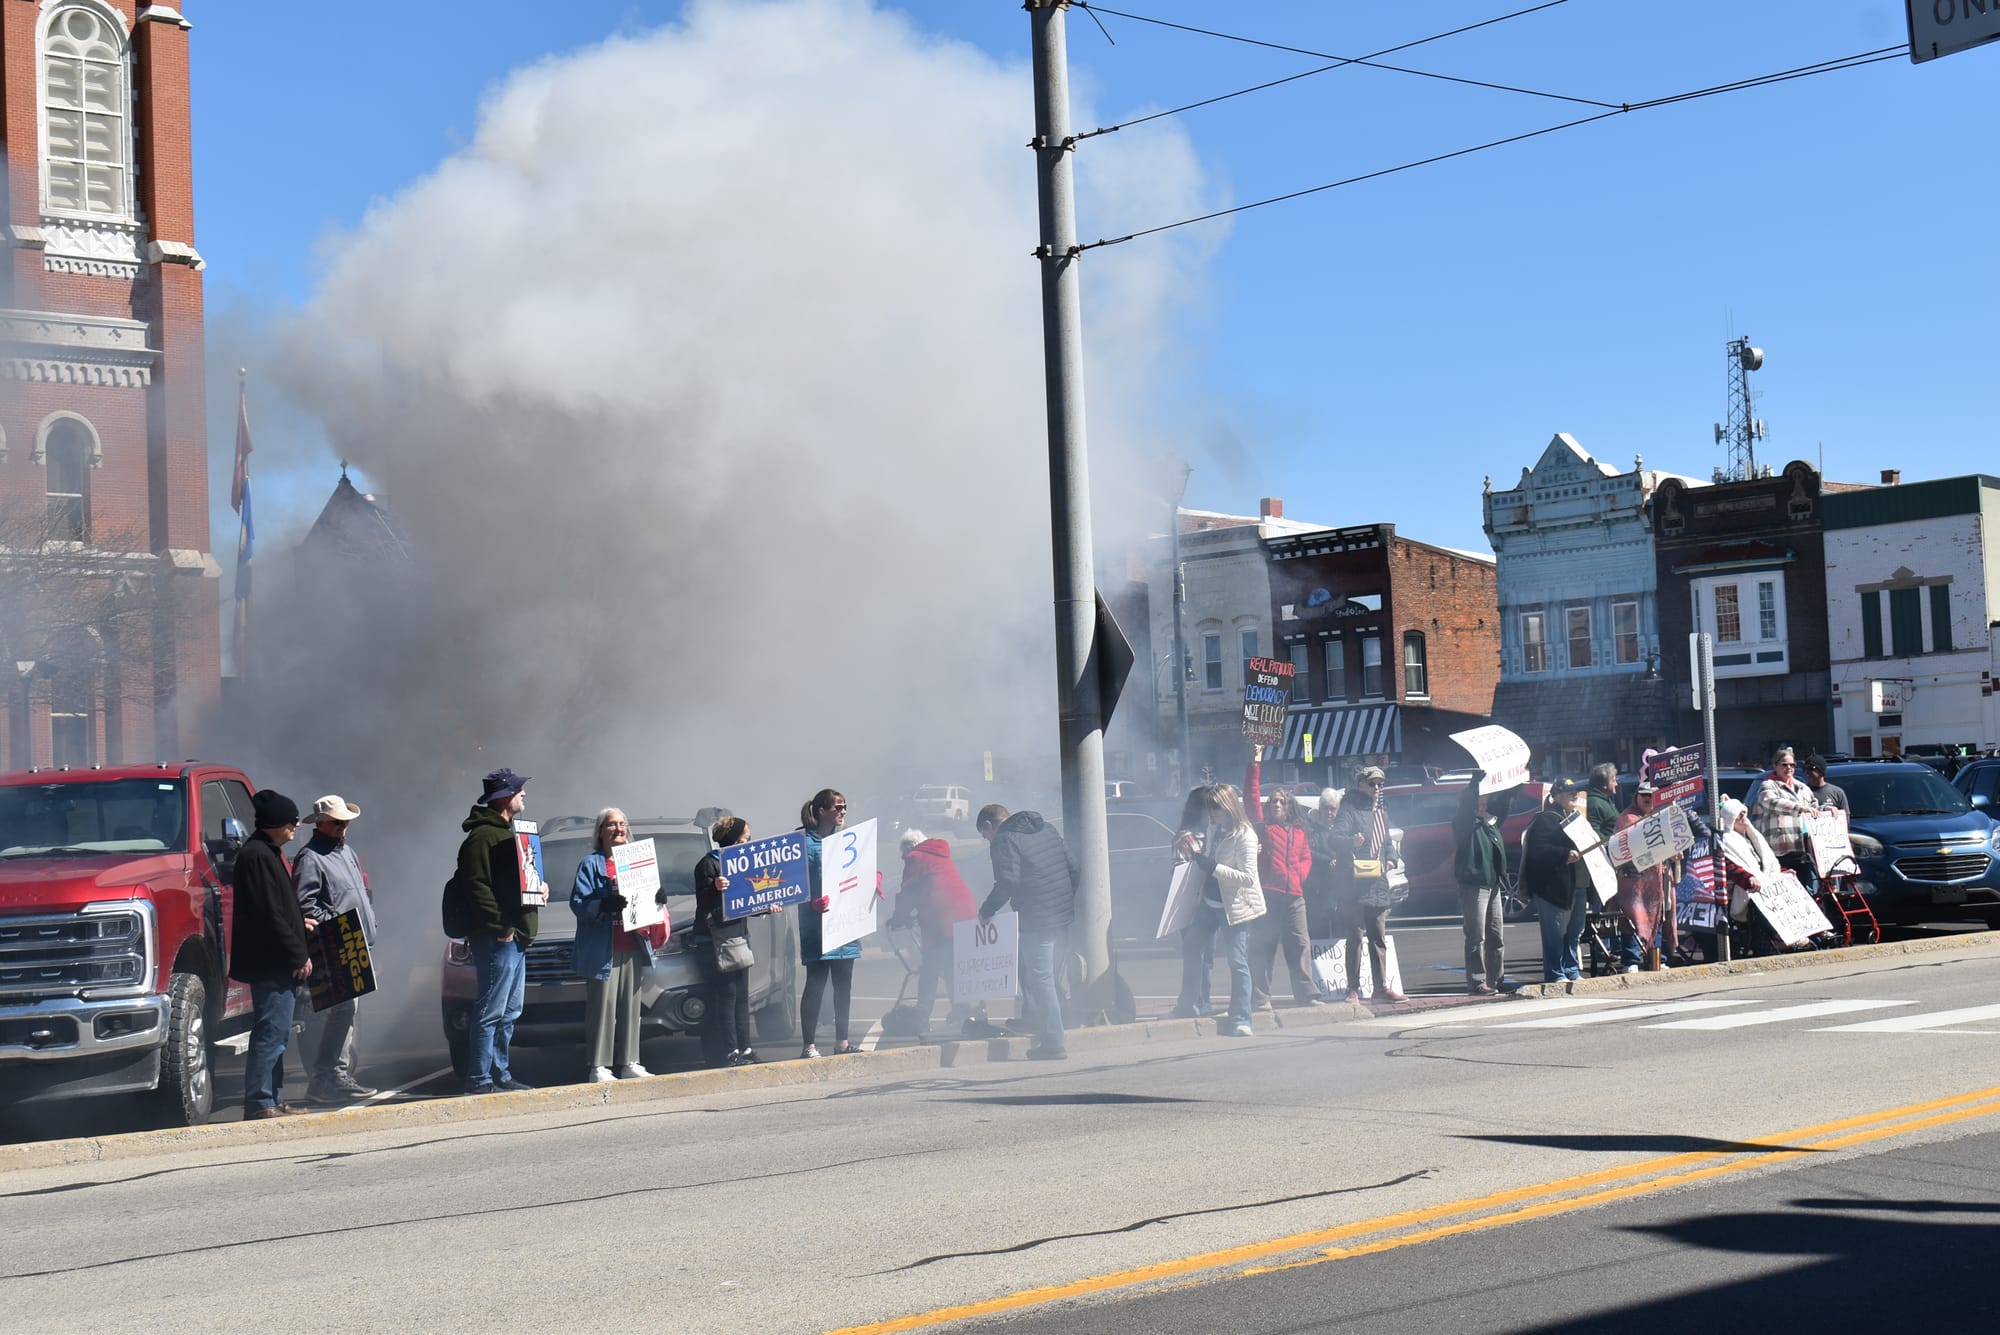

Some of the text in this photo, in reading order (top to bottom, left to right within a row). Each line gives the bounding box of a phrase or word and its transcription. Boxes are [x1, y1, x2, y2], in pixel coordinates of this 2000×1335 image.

[1933, 0, 2000, 26] ON
[1250, 657, 1296, 678] REAL PATRIOTS
[1257, 673, 1279, 686] DEFEND
[1245, 684, 1289, 706] DEMOCRACY
[1244, 704, 1286, 724] NOT PEDOS
[1653, 751, 1700, 769] NO KINGS
[1491, 770, 1503, 785] NO
[1654, 763, 1700, 780] AMERICA
[1660, 783, 1695, 801] DICTATOR
[1676, 795, 1697, 807] CRACY
[615, 843, 652, 858] PRESIDENTS
[726, 843, 802, 876] NO KINGS
[842, 832, 858, 869] 3
[620, 869, 642, 882] NO ONE
[731, 884, 802, 910] IN AMERICA
[1759, 880, 1789, 904] NAZIS
[751, 904, 769, 913] SINCE
[975, 922, 998, 948] NO
[338, 915, 365, 993] KINGS
[339, 948, 348, 966] IN
[353, 929, 370, 969] NO
